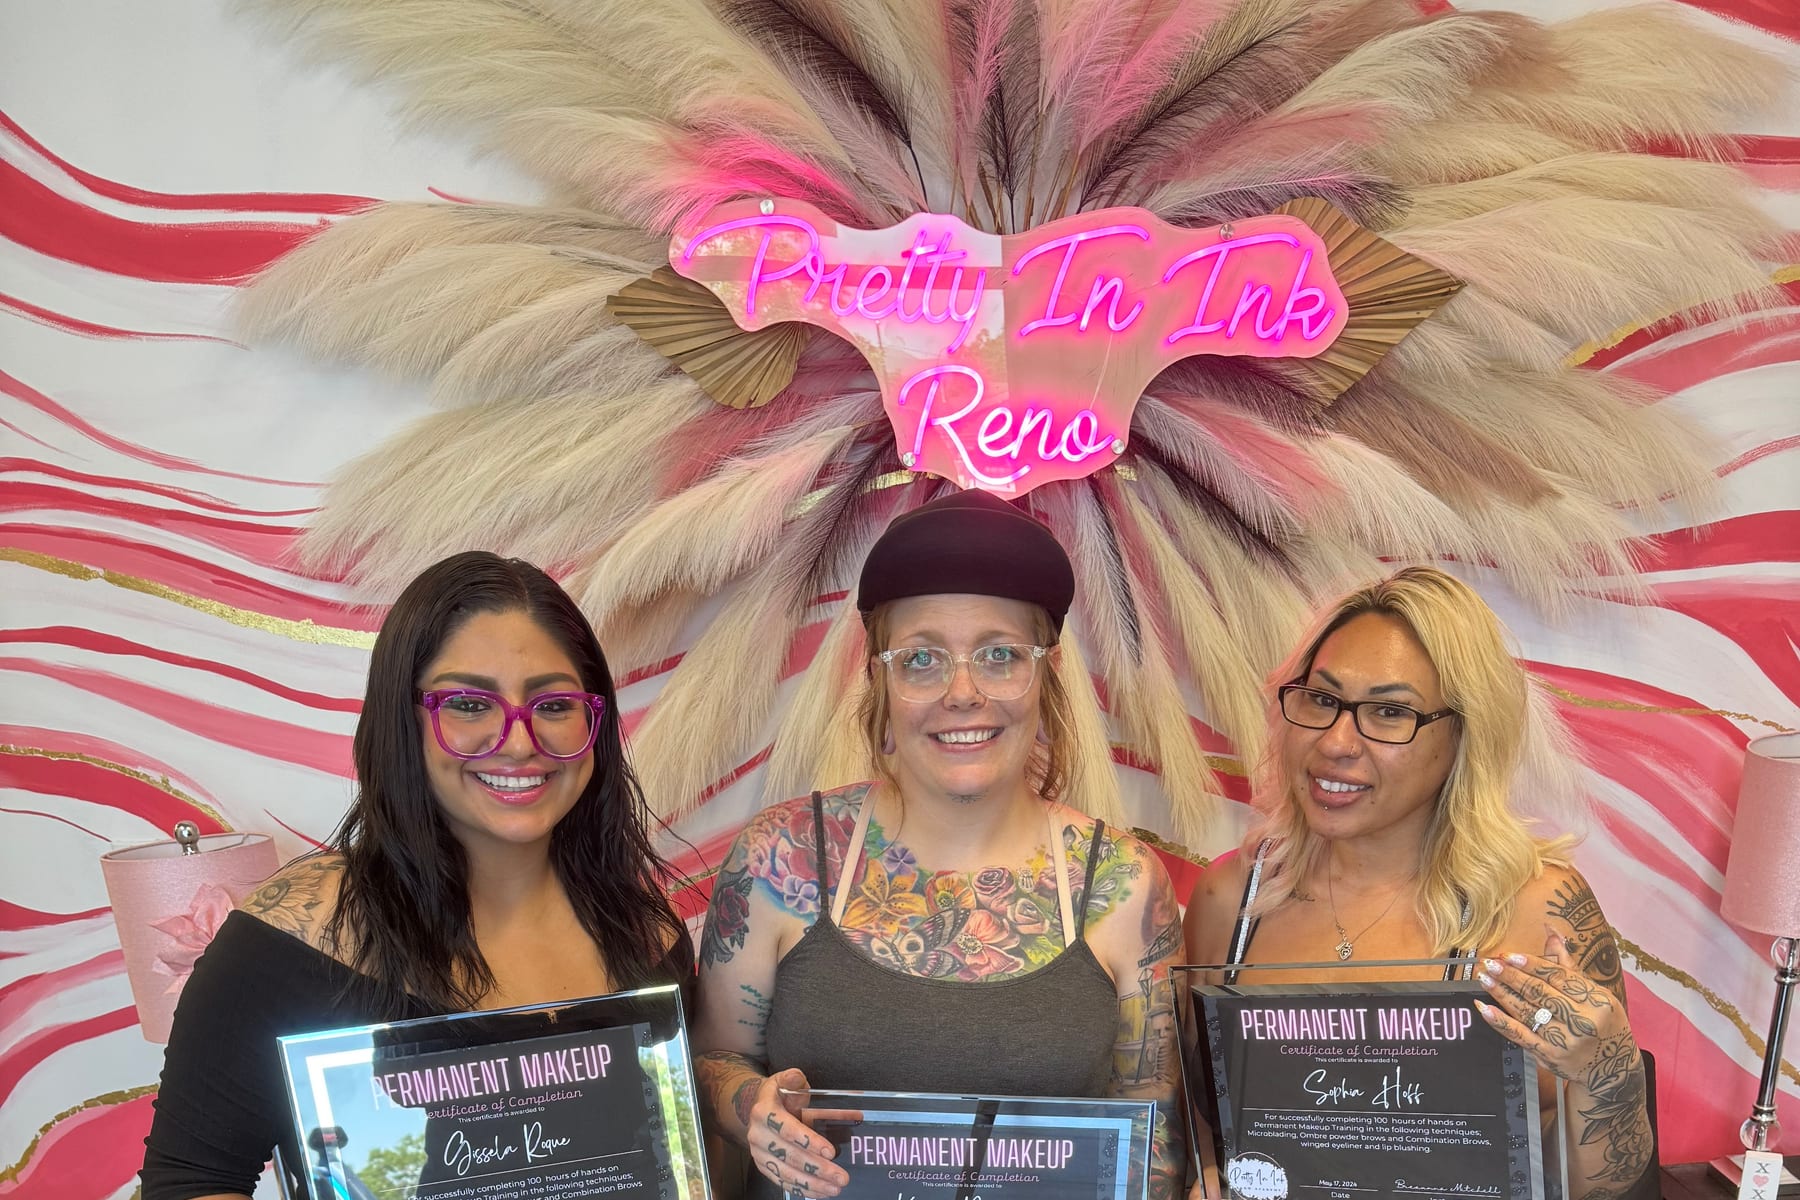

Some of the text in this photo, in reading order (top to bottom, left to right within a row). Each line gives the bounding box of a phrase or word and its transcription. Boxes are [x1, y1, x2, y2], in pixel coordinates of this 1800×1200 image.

[685, 214, 1335, 352] Pretty In Ink
[900, 365, 1112, 485] Reno
[1240, 1007, 1472, 1041] PERMANENT MAKEUP
[1280, 1044, 1438, 1057] Certificate of Completion
[370, 1044, 612, 1110] PERMANENT MAKEUP
[1303, 1066, 1425, 1109] Sophia Hoff
[424, 1089, 583, 1120] ertificate of Completion
[472, 1113, 502, 1122] certificate
[510, 1107, 537, 1116] awarded
[1254, 1121, 1297, 1129] Permanent
[1299, 1124, 1330, 1132] Makeup
[1332, 1124, 1364, 1133] Training
[1391, 1126, 1430, 1135] following
[1431, 1128, 1482, 1137] techniques;
[1279, 1114, 1325, 1123] successfully
[1326, 1116, 1372, 1124] completing
[444, 1122, 571, 1175] Gissela Roque
[1247, 1130, 1299, 1139] Microblading,
[1405, 1136, 1461, 1144] Combination
[1462, 1138, 1492, 1146] Brows,
[1300, 1141, 1330, 1149] winged
[1331, 1142, 1362, 1150] eyeliner
[850, 1135, 977, 1167] PERMANENT
[987, 1138, 1073, 1169] MAKEUP
[888, 1169, 1040, 1184] Certificate of Completion
[1756, 1163, 1771, 1174] X
[477, 1180, 525, 1193] completing
[527, 1176, 541, 1184] 100
[545, 1173, 569, 1182] hours
[571, 1170, 579, 1178] of
[581, 1167, 606, 1176] hands
[530, 1187, 545, 1195] the
[546, 1181, 584, 1193] following
[585, 1172, 634, 1186] techniques;
[561, 1185, 615, 1199] Combination
[617, 1180, 643, 1190] Brows
[1752, 1189, 1766, 1200] X
